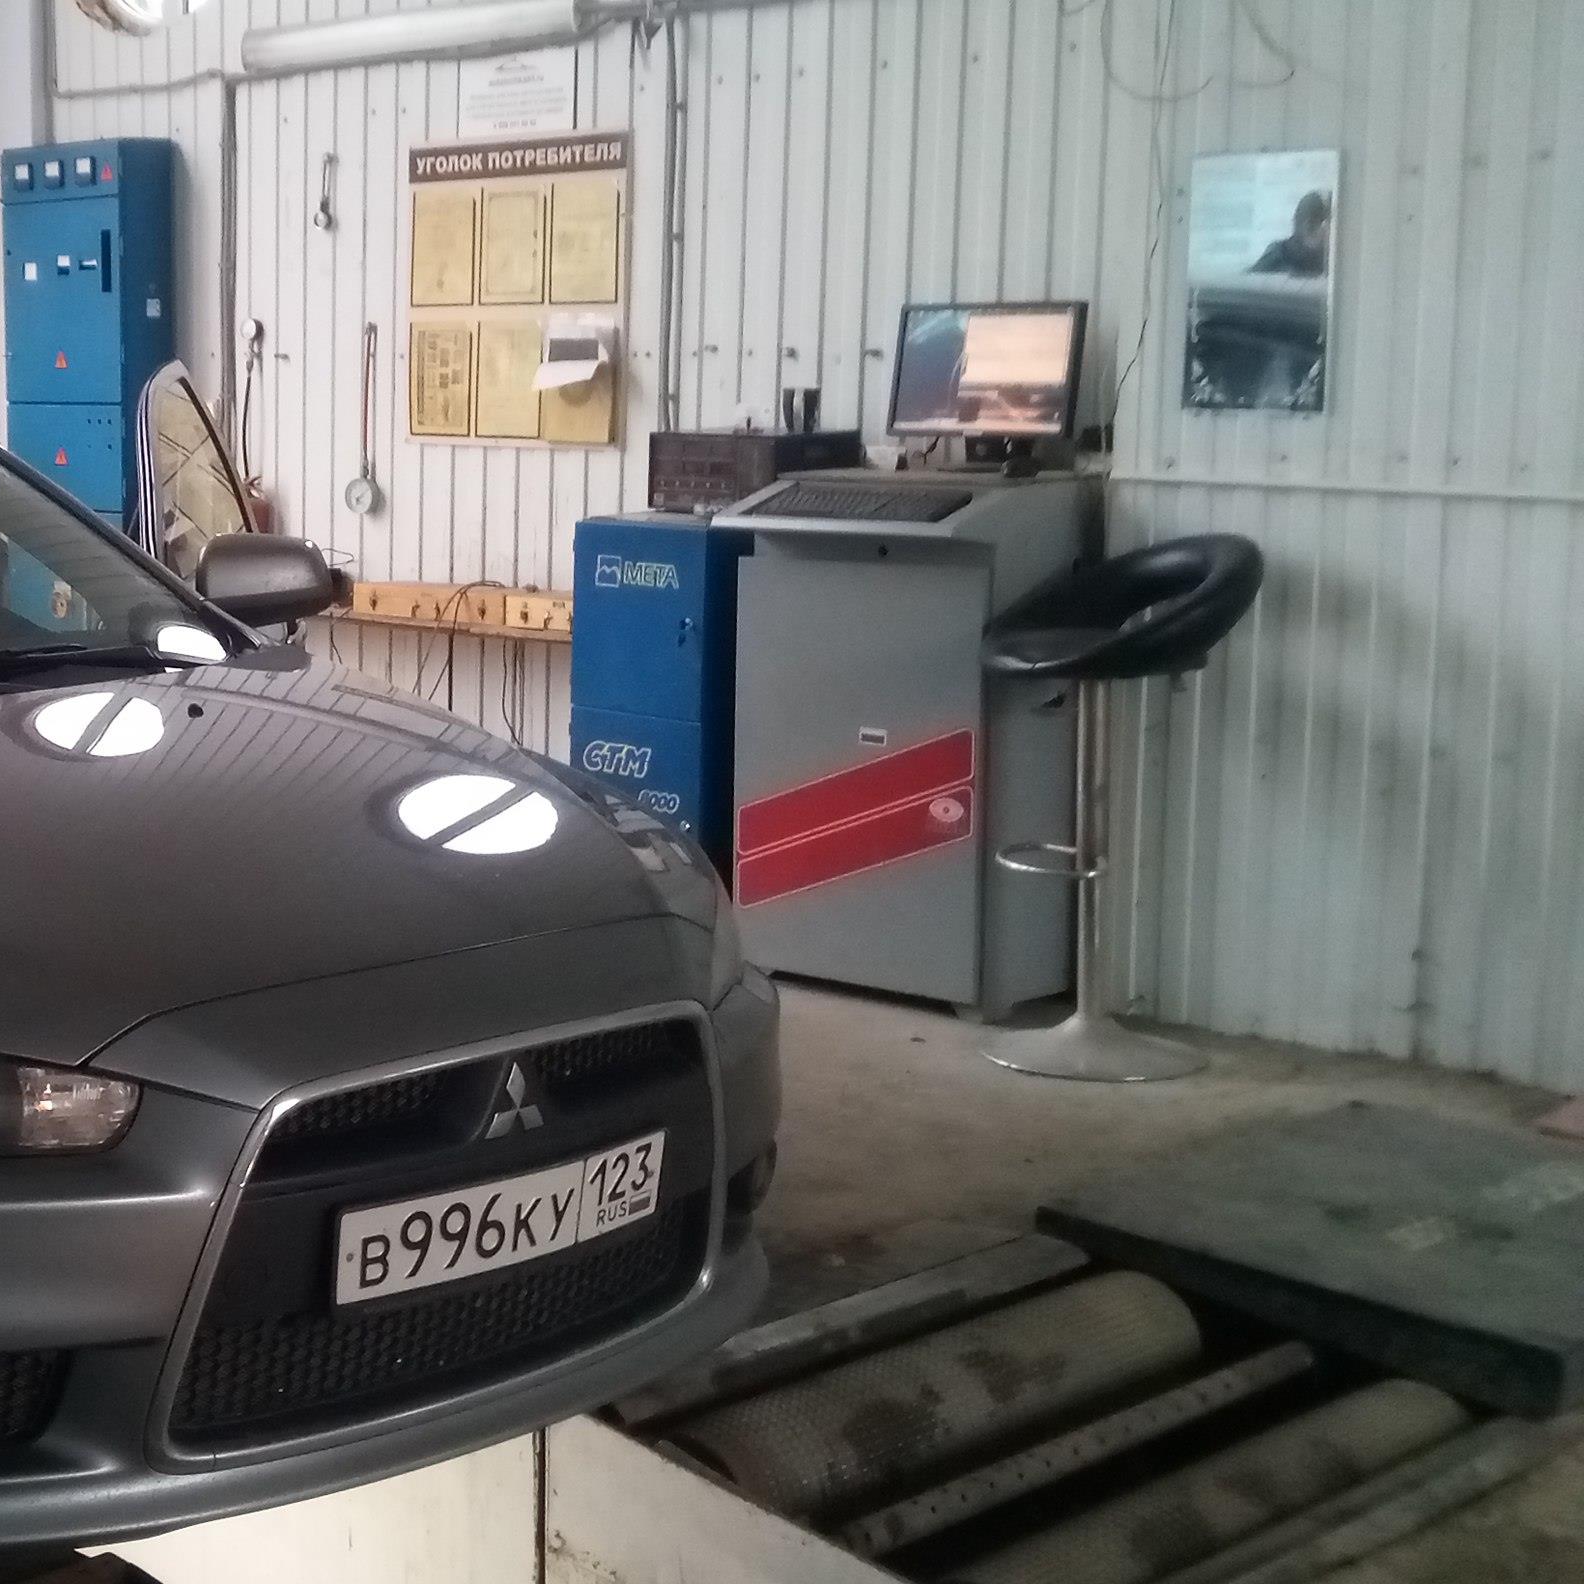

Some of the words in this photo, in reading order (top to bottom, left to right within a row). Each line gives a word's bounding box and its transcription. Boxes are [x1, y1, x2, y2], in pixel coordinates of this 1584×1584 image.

[416, 152, 483, 176] УГОЛОК
[487, 141, 622, 171] ПОТРЕБИТЕЛЯ
[359, 1188, 575, 1289] В996КУ
[589, 1142, 653, 1206] 123
[596, 1200, 628, 1228] RUS
